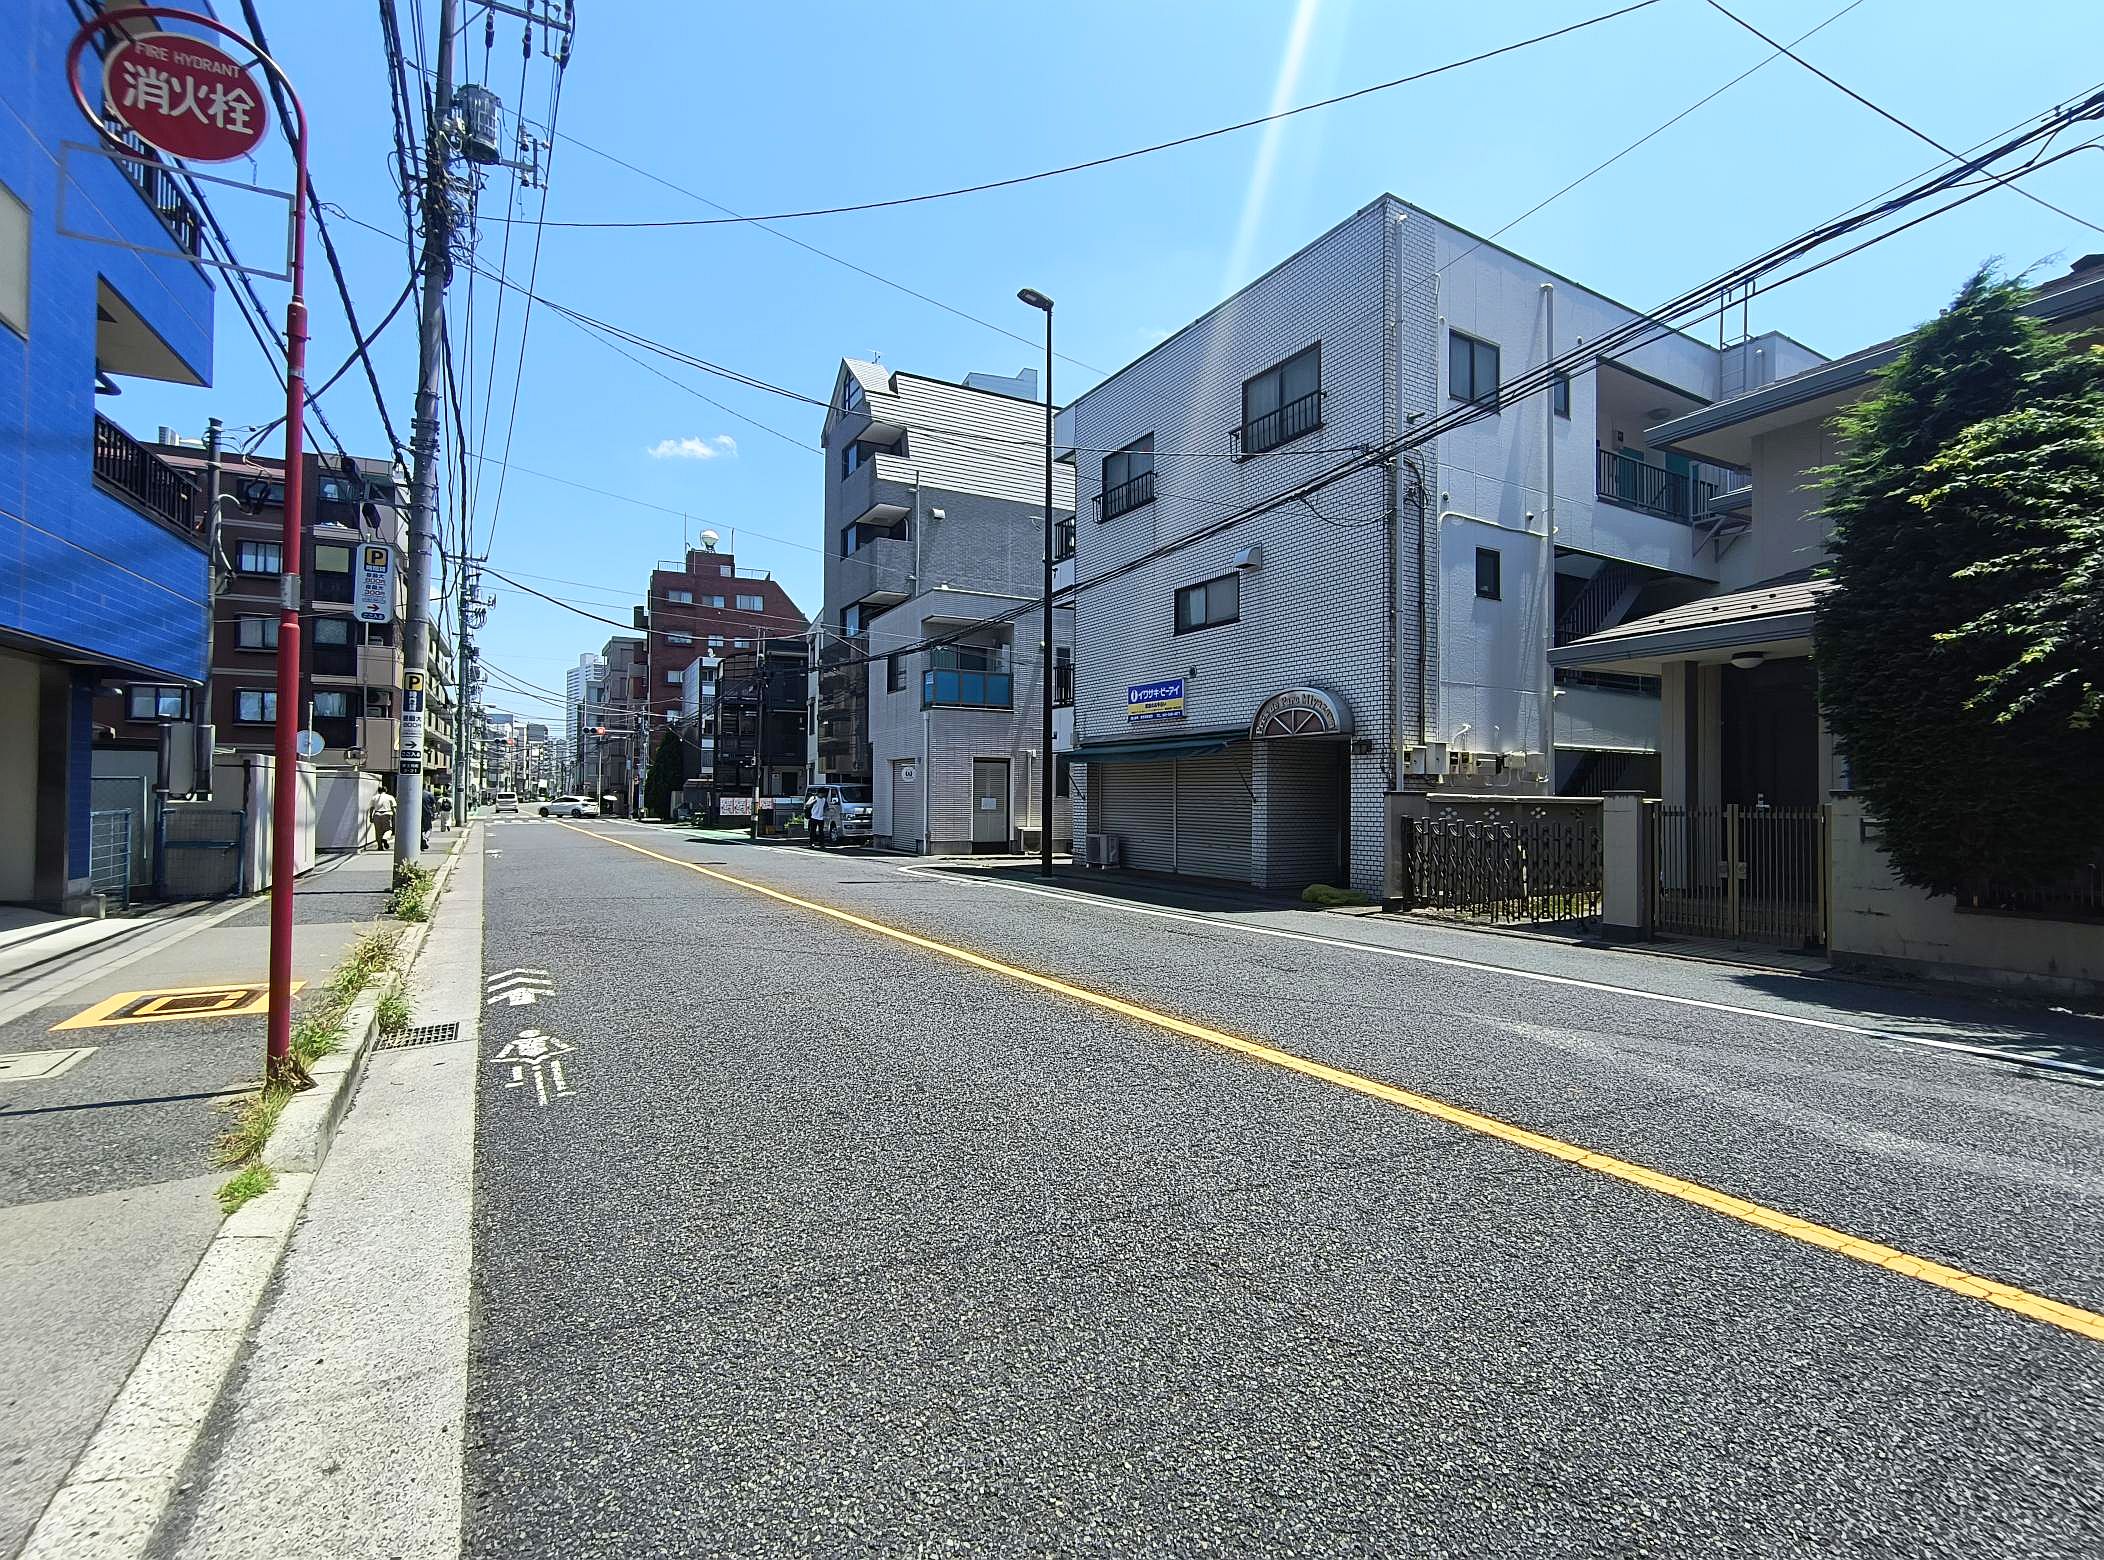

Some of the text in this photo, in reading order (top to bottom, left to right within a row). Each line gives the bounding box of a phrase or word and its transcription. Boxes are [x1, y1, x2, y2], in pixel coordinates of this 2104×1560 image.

[134, 42, 242, 79] FIRE HYDRANT
[122, 60, 256, 135] 消火栓
[371, 550, 384, 564] P
[408, 675, 421, 689] P
